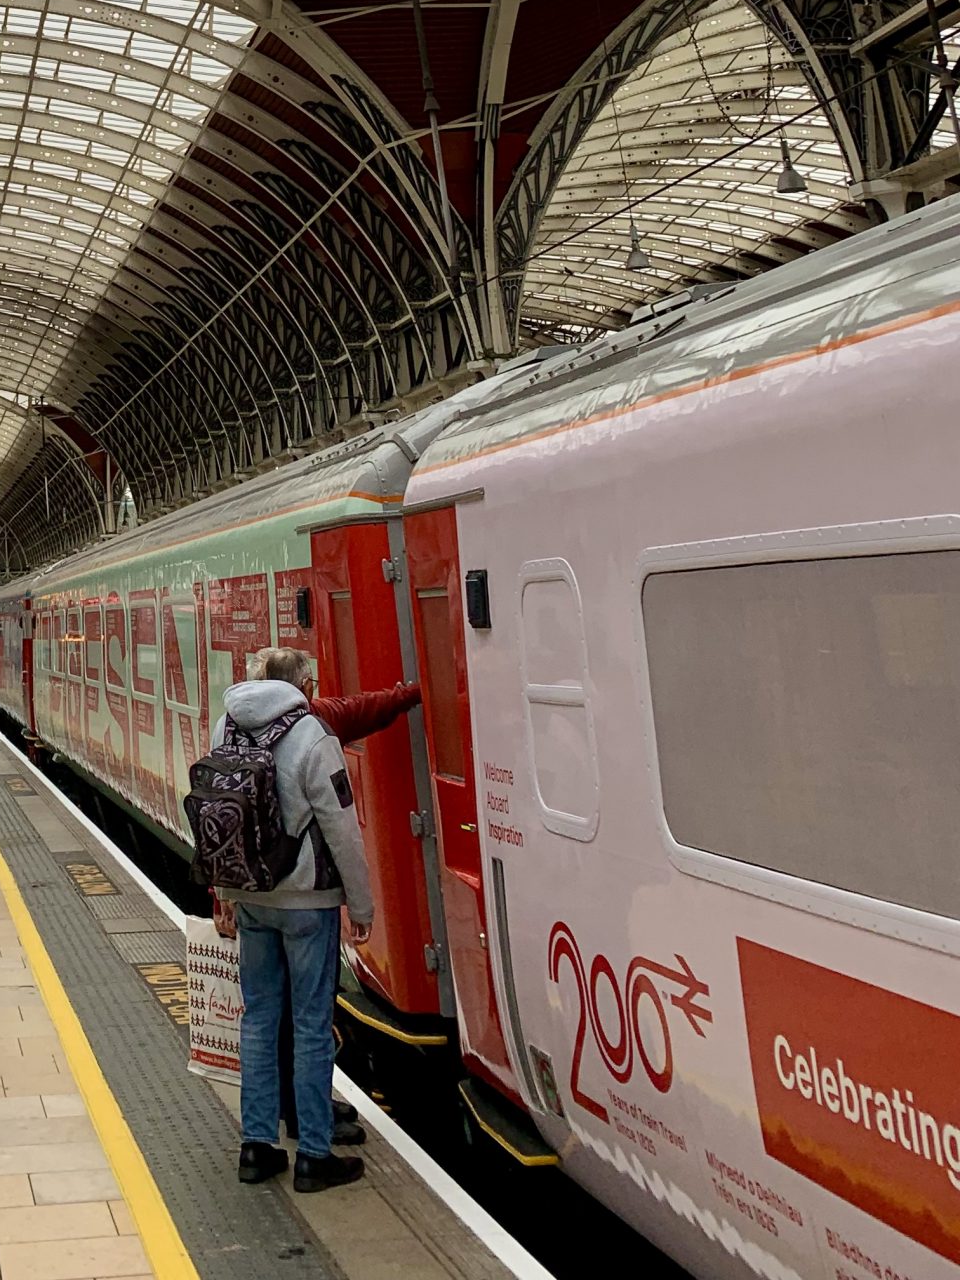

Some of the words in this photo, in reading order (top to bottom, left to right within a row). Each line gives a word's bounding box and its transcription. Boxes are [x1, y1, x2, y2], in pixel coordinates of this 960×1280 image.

[483, 761, 514, 787] Welcome
[486, 790, 509, 815] Aboard
[487, 818, 524, 848] Inspiration
[607, 1087, 630, 1116] Years
[629, 1103, 639, 1120] of
[638, 1107, 660, 1136] Train
[659, 1121, 689, 1154] Travel
[774, 1034, 960, 1190] Celebrating
[614, 1116, 638, 1144] Since
[636, 1130, 658, 1157] 1825
